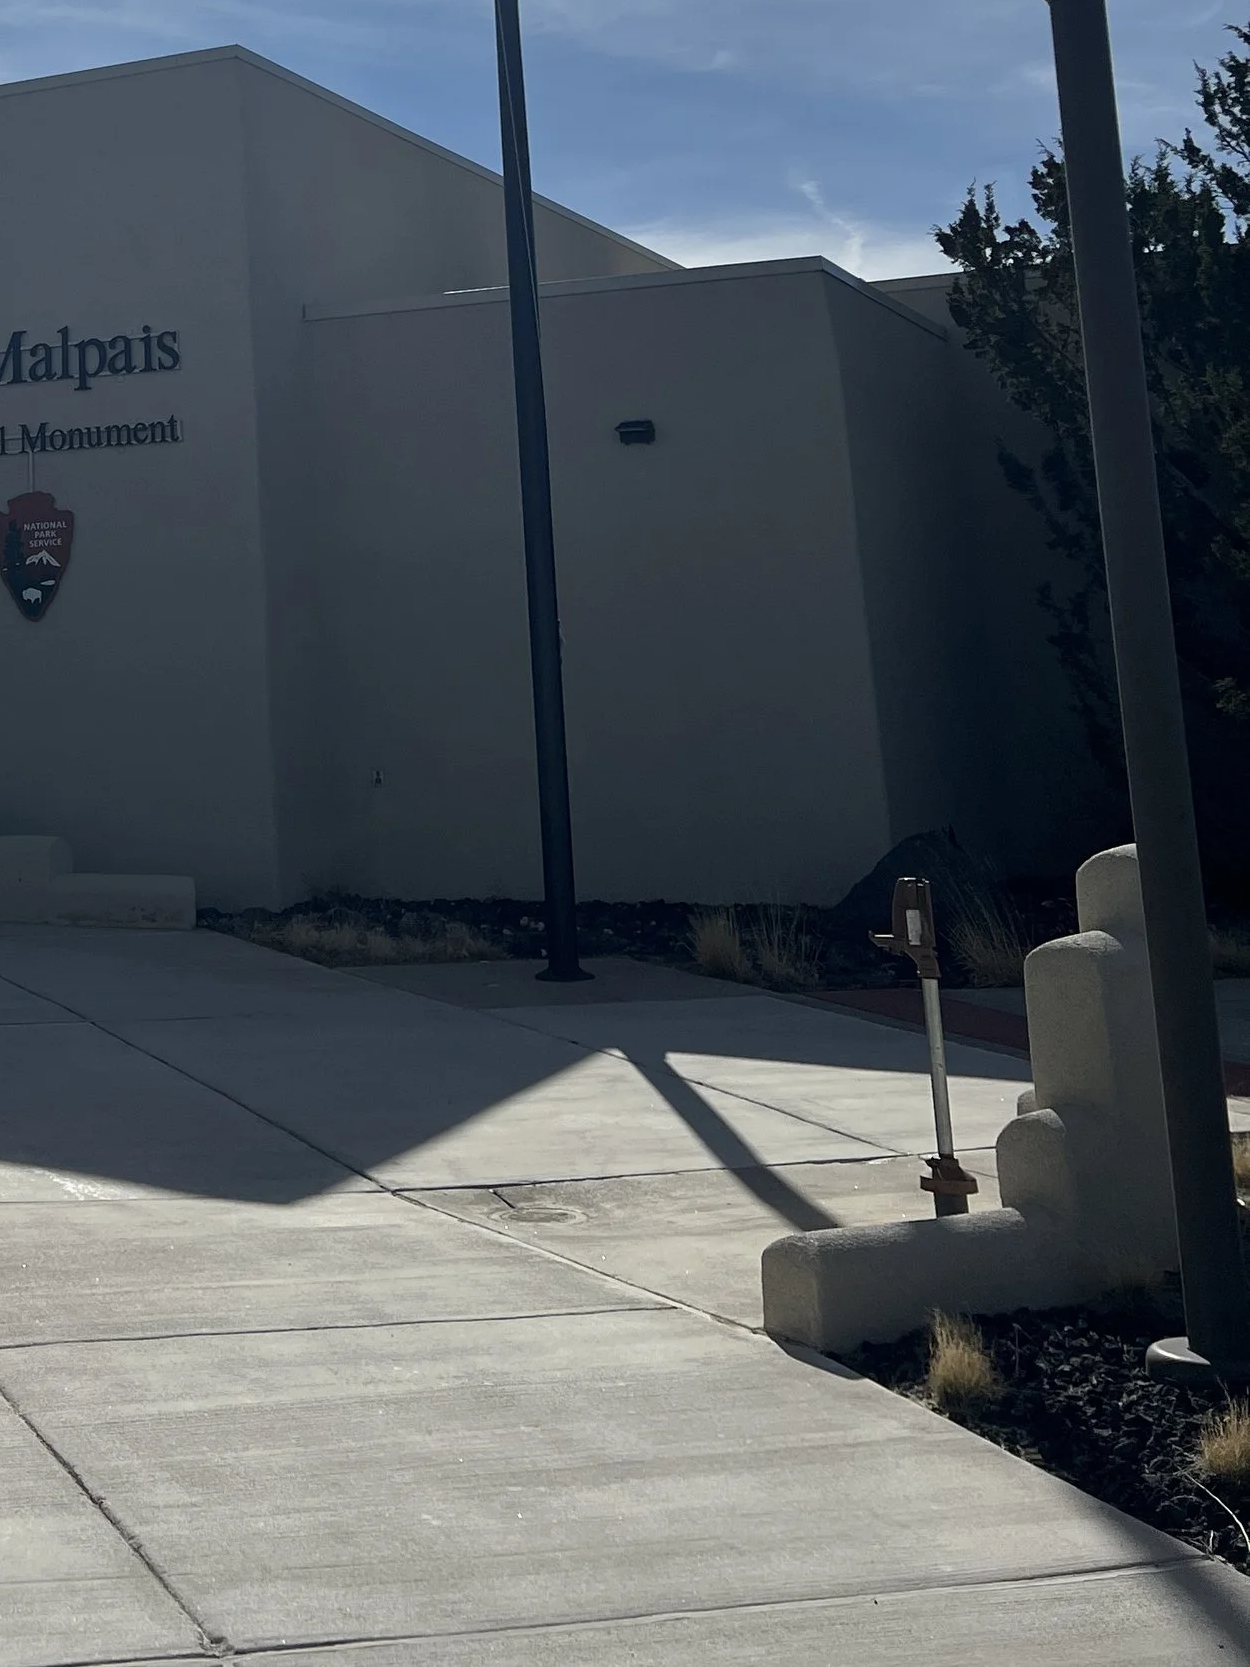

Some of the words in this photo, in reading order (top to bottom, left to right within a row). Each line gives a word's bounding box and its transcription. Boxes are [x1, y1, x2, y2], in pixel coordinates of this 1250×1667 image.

[19, 414, 180, 453] Monument
[23, 521, 67, 531] NATIONAL
[34, 530, 57, 538] PARK
[29, 538, 63, 548] SERVICE
